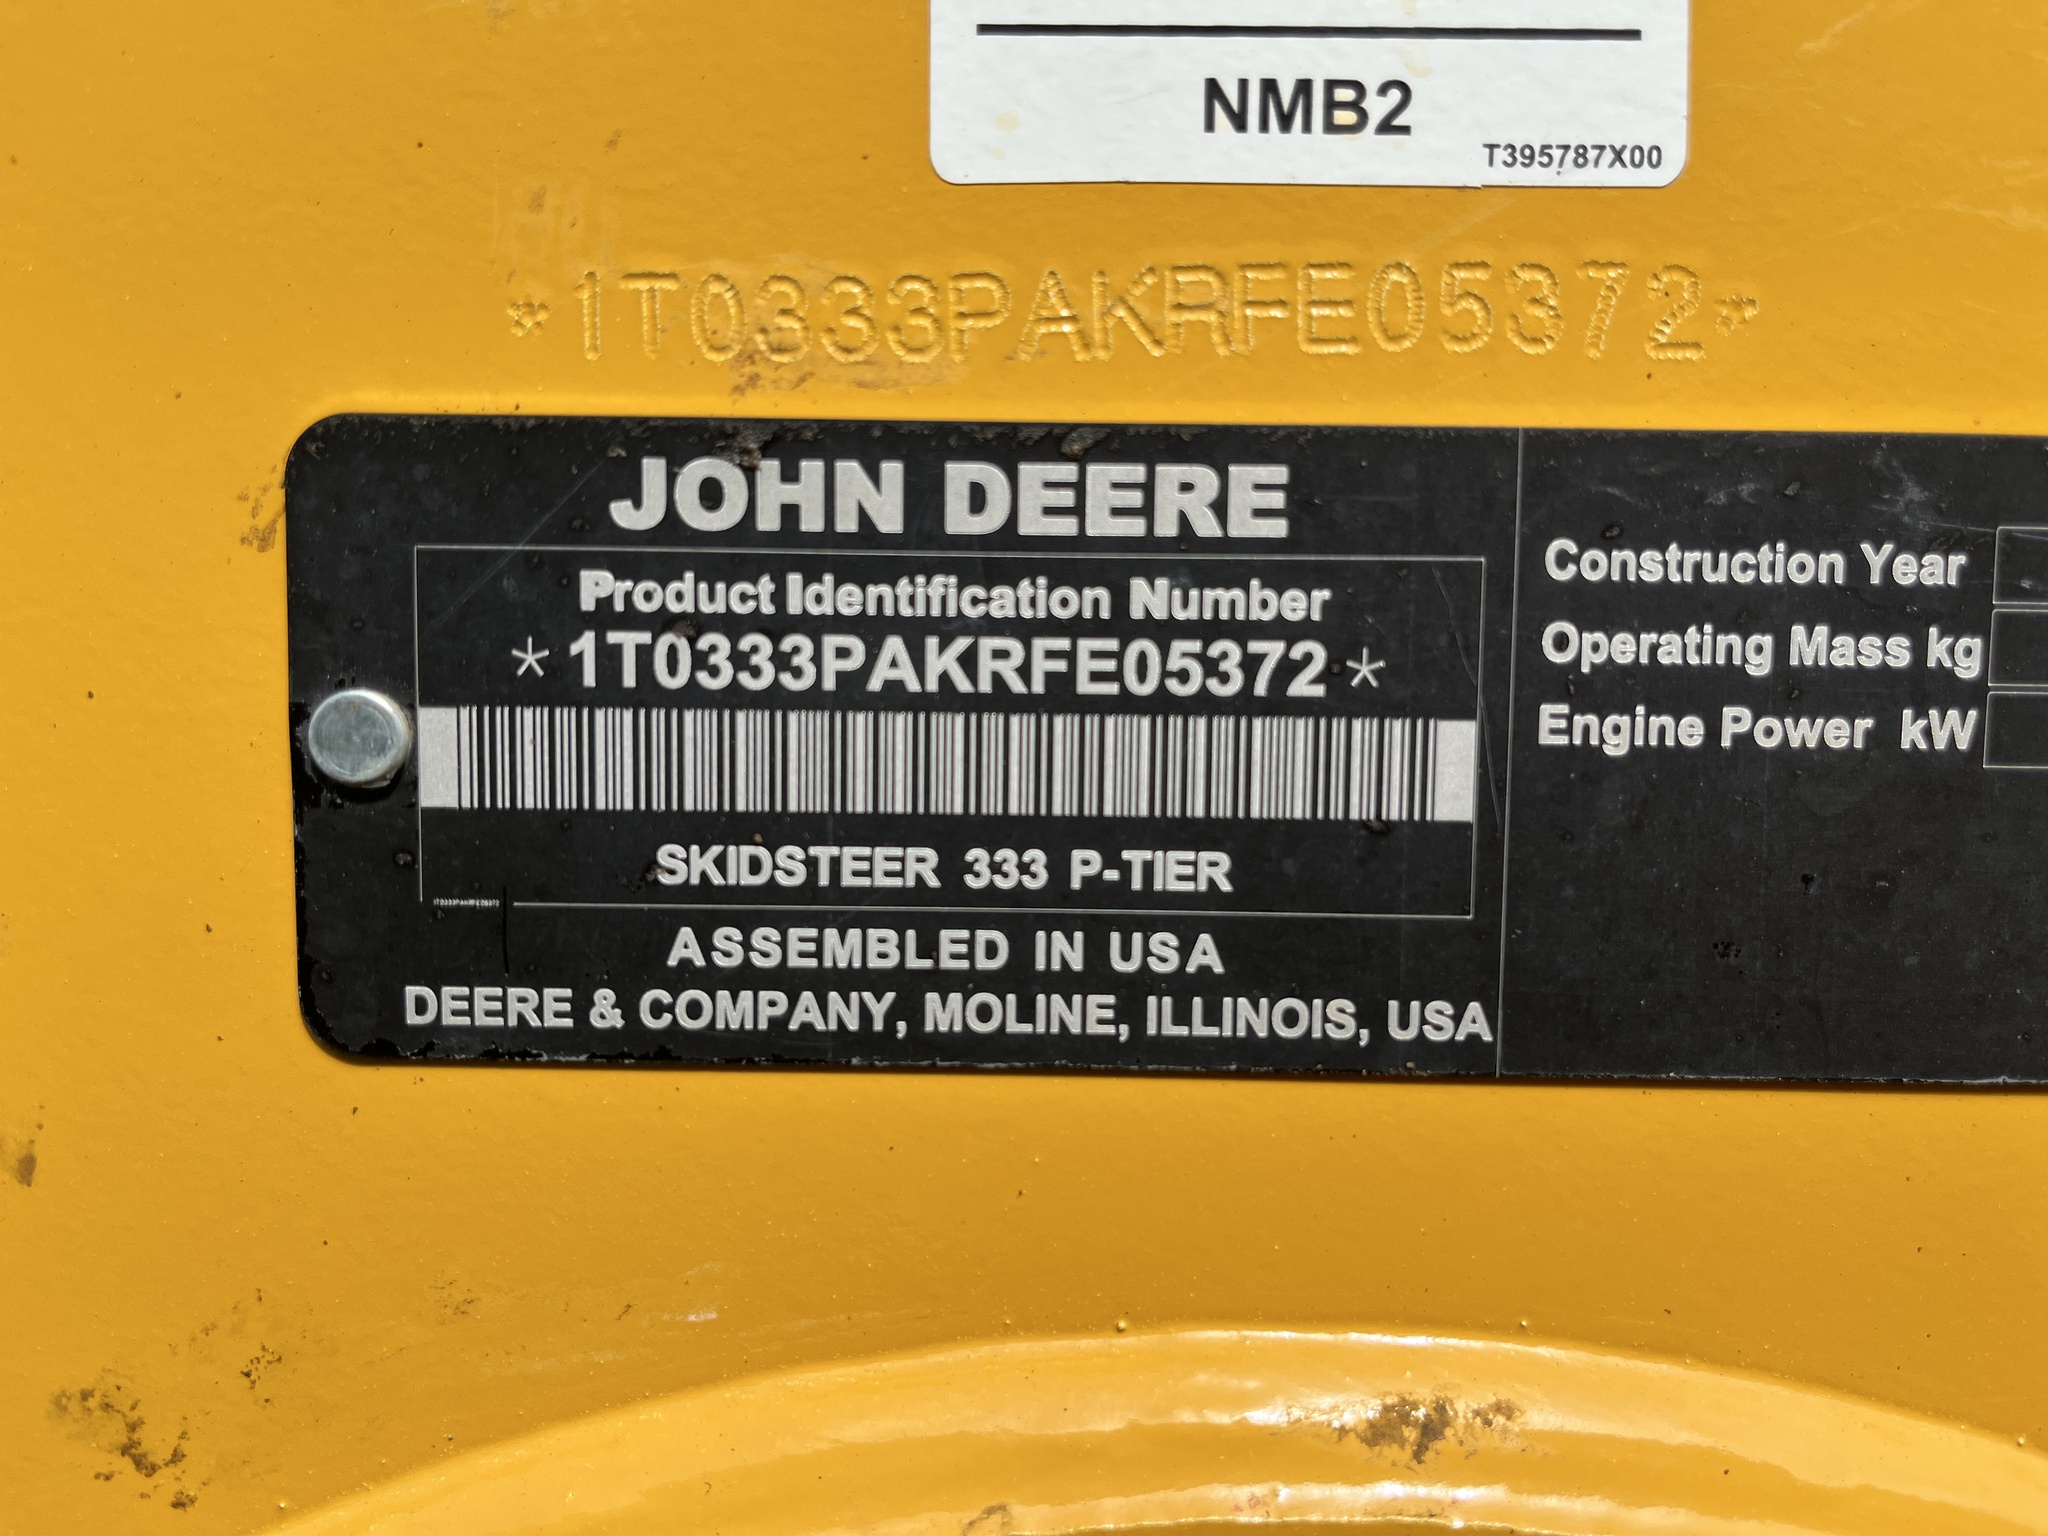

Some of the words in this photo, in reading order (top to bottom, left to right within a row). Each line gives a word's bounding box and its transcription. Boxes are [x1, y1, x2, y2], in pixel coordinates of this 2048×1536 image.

[1205, 78, 1411, 135] NMB2
[1484, 144, 1661, 168] T395787X00
[610, 458, 903, 533] JOHN
[945, 462, 1288, 538] DEERE
[1545, 539, 1844, 584] Construction
[1860, 543, 1966, 586] Year
[580, 570, 775, 614] Product
[787, 573, 1110, 619] Identification
[1130, 577, 1331, 621] Number
[570, 631, 1326, 697] 1T0333PAKRFE05372
[1542, 621, 1772, 676] Operating
[1790, 625, 1911, 667] Mass
[1927, 627, 1982, 679] kg
[1539, 704, 1704, 756] Engine
[1721, 706, 1874, 749] Power
[1901, 709, 1977, 750] kW
[657, 844, 941, 887] SKIDSTEER
[964, 848, 1048, 889] 333
[1071, 849, 1232, 892] P-TIER
[667, 927, 1008, 969] ASSEMBLED
[1036, 931, 1083, 971] IN
[1110, 932, 1224, 973] USA
[405, 986, 573, 1027] DEERE
[590, 989, 624, 1028] &
[640, 989, 906, 1038] COMPANY,
[925, 993, 1128, 1041] MOLINE,
[1147, 996, 1368, 1046] ILLINOIS,
[1388, 1000, 1492, 1041] USA
